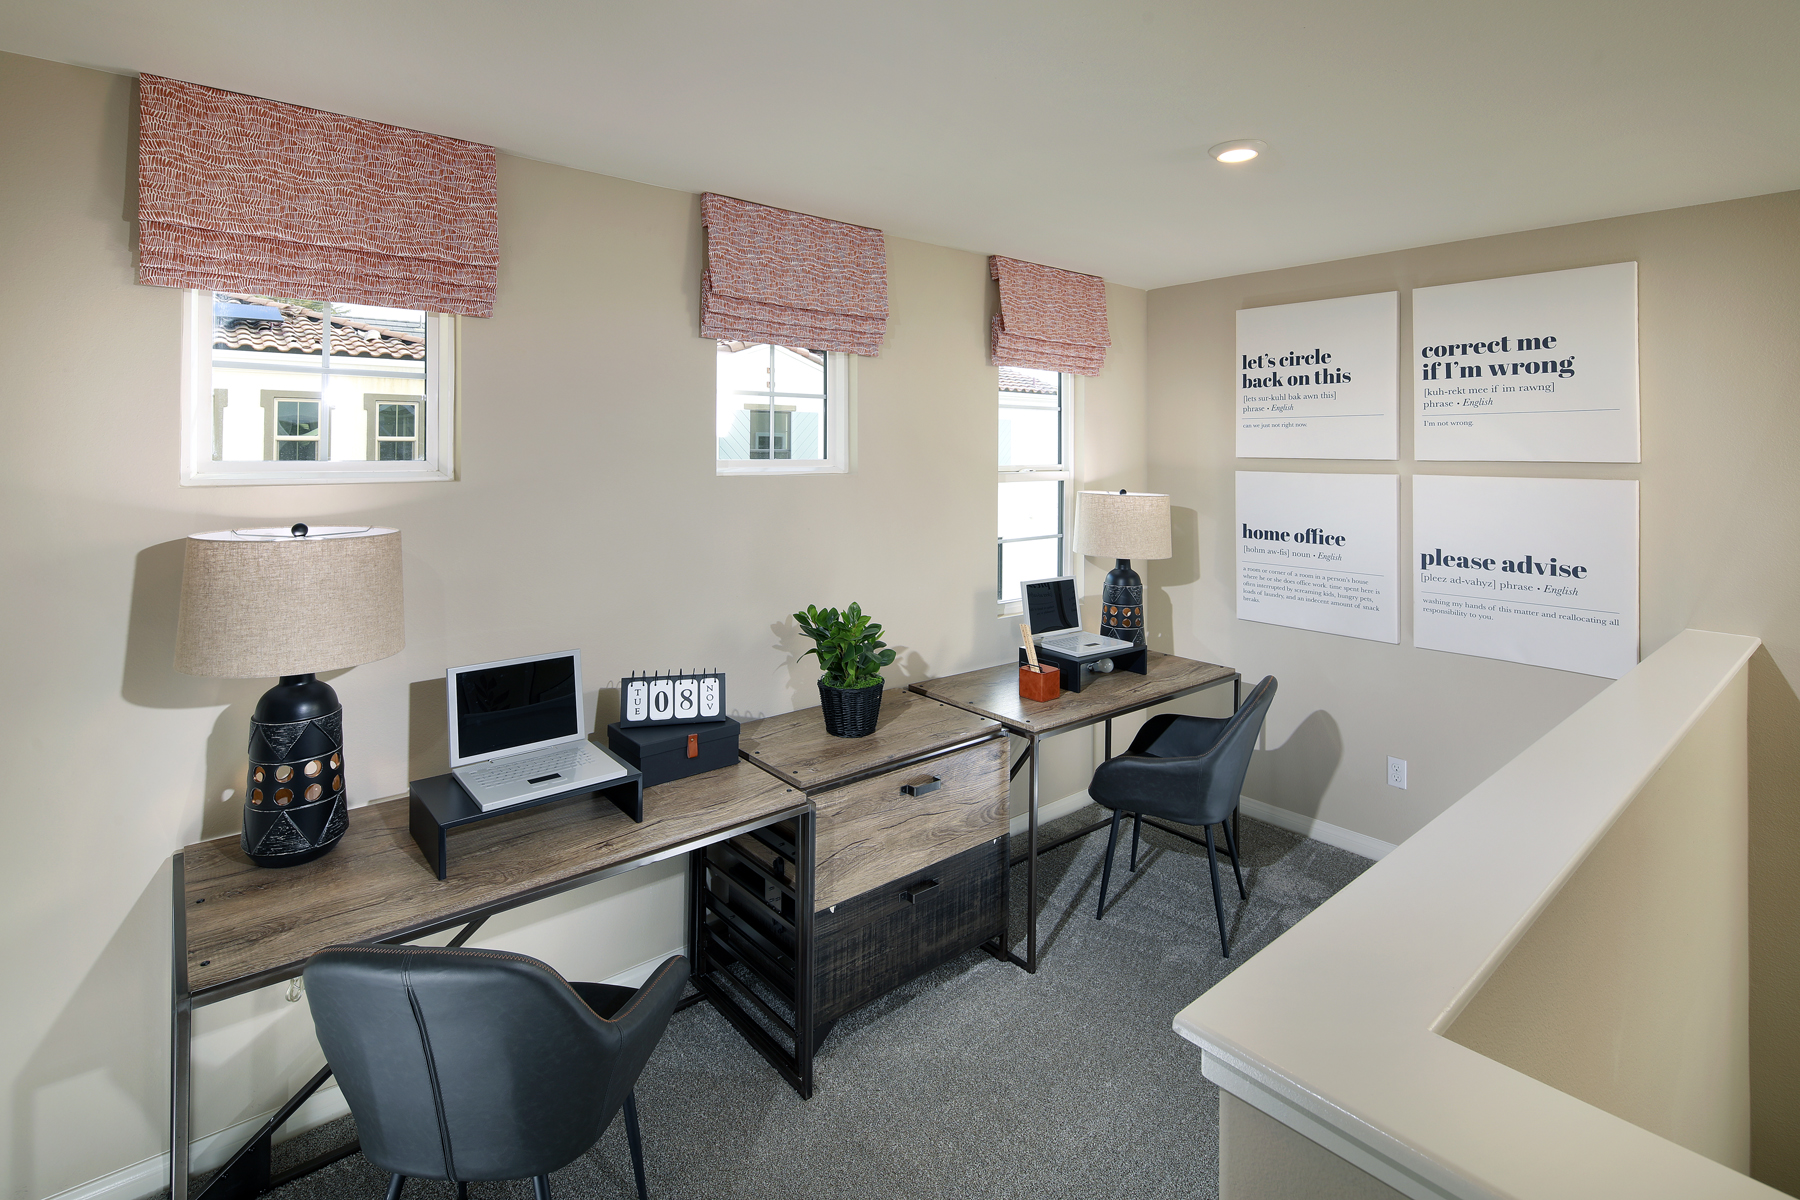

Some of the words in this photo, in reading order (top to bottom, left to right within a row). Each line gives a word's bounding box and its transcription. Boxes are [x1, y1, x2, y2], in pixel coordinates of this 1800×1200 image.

[1421, 336, 1512, 358] correct
[1517, 335, 1557, 351] me
[1242, 354, 1276, 370] let's
[1279, 349, 1332, 367] circle
[1422, 361, 1441, 380] if
[1444, 361, 1482, 379] I'm
[1488, 356, 1575, 378] wrong
[1242, 372, 1283, 388] back
[1287, 374, 1310, 386] on
[1314, 368, 1351, 385] this
[1244, 395, 1256, 404] [lets
[1321, 391, 1336, 400] this]
[1424, 386, 1466, 398] [kuh-rekt
[1491, 384, 1499, 393] if
[1519, 382, 1555, 393] rawng]
[1243, 406, 1265, 414] phrase
[1271, 404, 1293, 413] English
[1424, 400, 1454, 410] phrase
[1463, 398, 1493, 408] English
[1242, 523, 1290, 542] home
[1294, 528, 1346, 546] office
[1267, 549, 1289, 558] aw-fis]
[1318, 552, 1342, 562] English
[1420, 548, 1496, 571] please
[1501, 555, 1588, 579] advise
[1421, 573, 1447, 583] [pleez
[1450, 576, 1496, 590] ad-vahyz]
[1500, 582, 1534, 591] phrase
[1544, 585, 1579, 597] English
[1338, 592, 1358, 601] hungry
[1423, 597, 1450, 606] washing
[1465, 602, 1486, 610] hands
[1559, 612, 1607, 626] reallocating
[1423, 607, 1468, 618] responsibility
